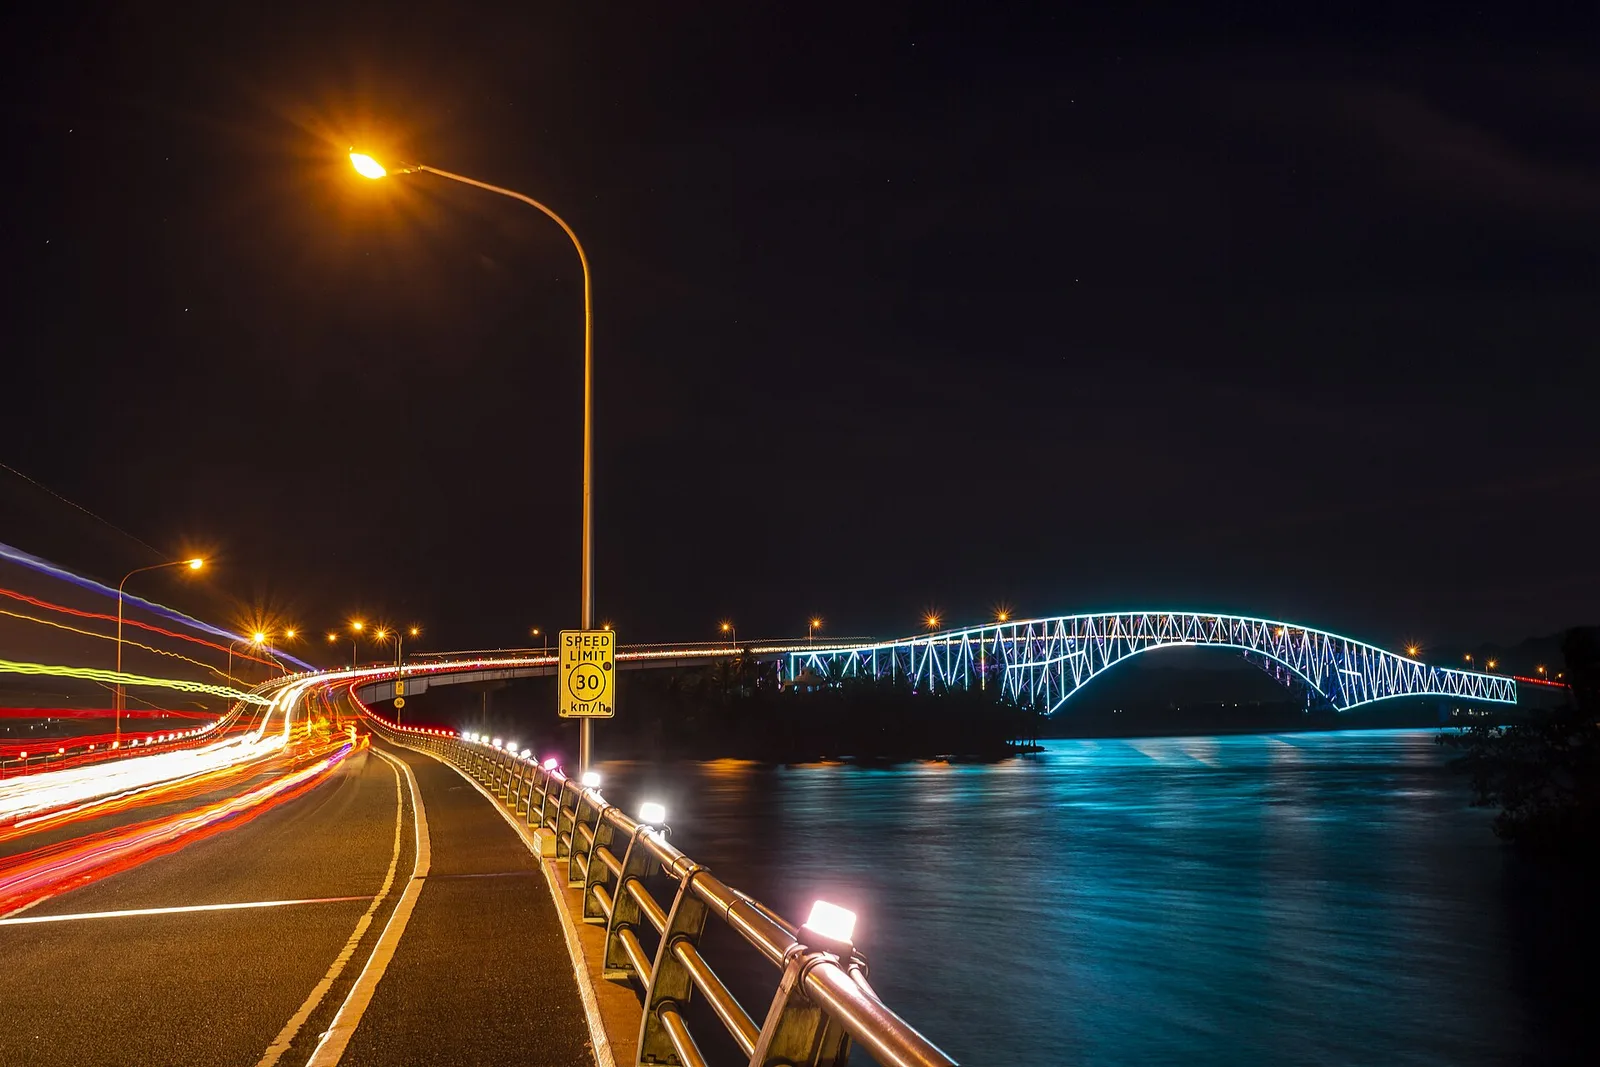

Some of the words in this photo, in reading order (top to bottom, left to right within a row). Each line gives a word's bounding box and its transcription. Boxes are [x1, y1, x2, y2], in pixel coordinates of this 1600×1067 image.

[565, 636, 609, 647] SPEED
[570, 650, 606, 661] LIMIT
[576, 674, 599, 690] 30
[570, 701, 606, 713] km/h
